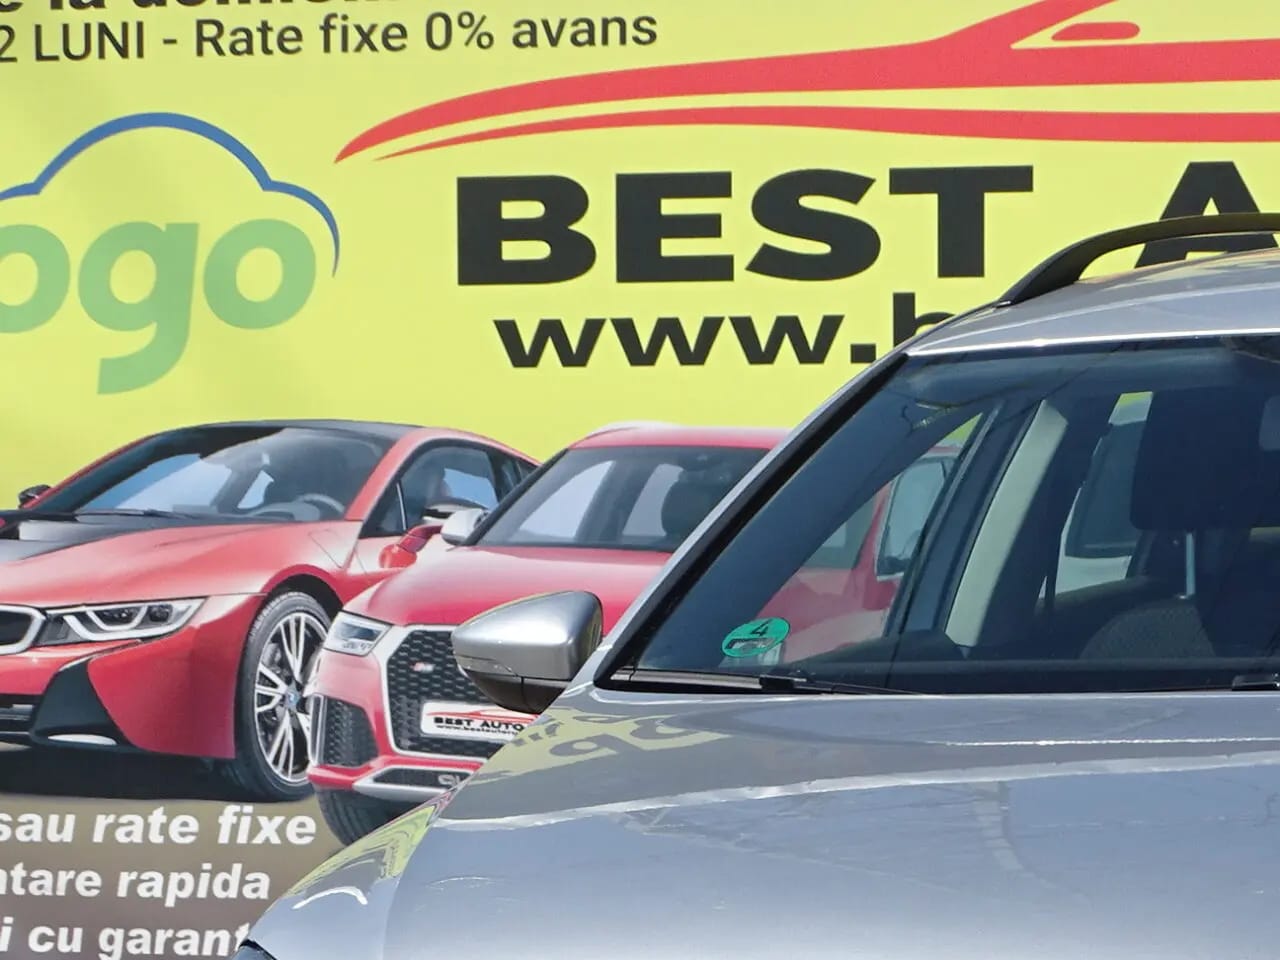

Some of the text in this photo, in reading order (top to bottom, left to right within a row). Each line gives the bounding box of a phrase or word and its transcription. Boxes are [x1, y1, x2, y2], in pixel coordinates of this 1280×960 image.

[34, 20, 145, 62] LUNI
[195, 18, 304, 58] Rate
[319, 12, 408, 53] fixe
[425, 11, 495, 51] 0%
[511, 15, 658, 49] avans
[456, 165, 1034, 286] BEST
[434, 717, 525, 732] BEST AUTO
[92, 804, 200, 844] rate
[216, 805, 317, 845] fixe
[116, 863, 271, 907] rapida
[27, 924, 84, 954] cu
